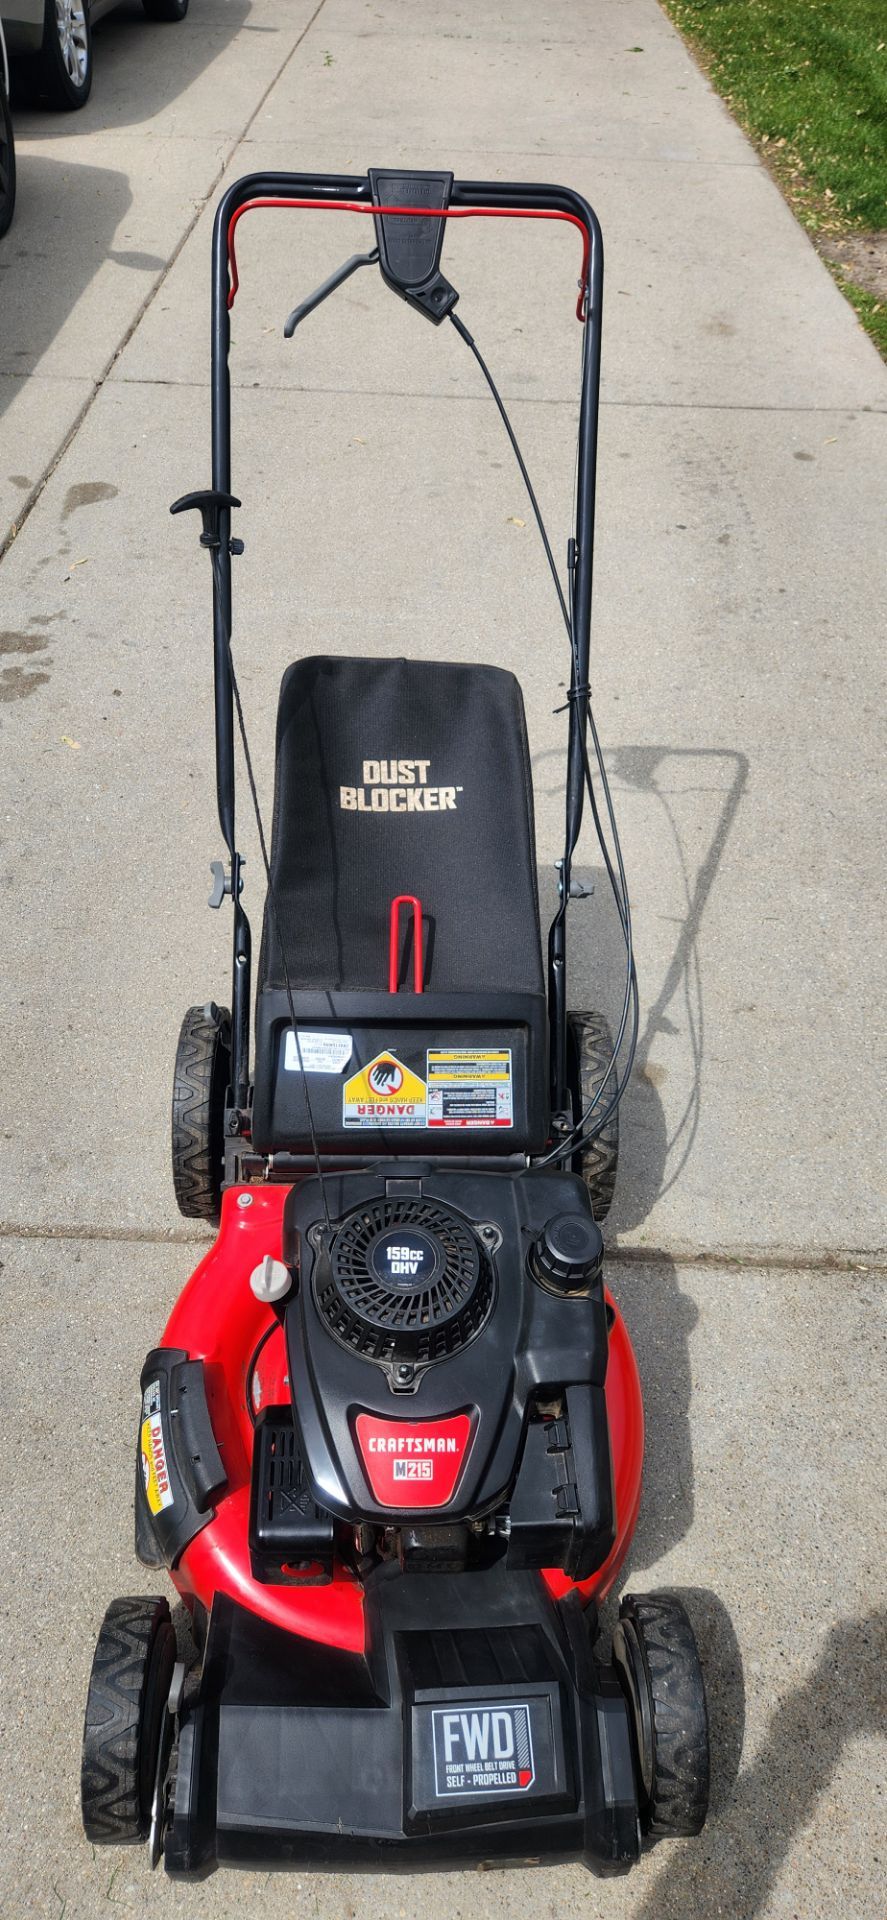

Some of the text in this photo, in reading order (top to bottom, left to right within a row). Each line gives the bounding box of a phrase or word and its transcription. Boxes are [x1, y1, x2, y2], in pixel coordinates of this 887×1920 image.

[363, 760, 431, 784] DUST
[357, 1104, 415, 1115] DANGER
[387, 1246, 424, 1261] 159cc
[391, 1261, 419, 1275] OHV
[151, 1426, 169, 1494] DANGER
[394, 1459, 434, 1480] M215
[443, 1711, 515, 1762] FWD
[445, 1760, 516, 1774] FRONT WHEEL BELT DRIVE
[446, 1775, 465, 1788] SELF
[472, 1771, 517, 1786] PROPELLED
